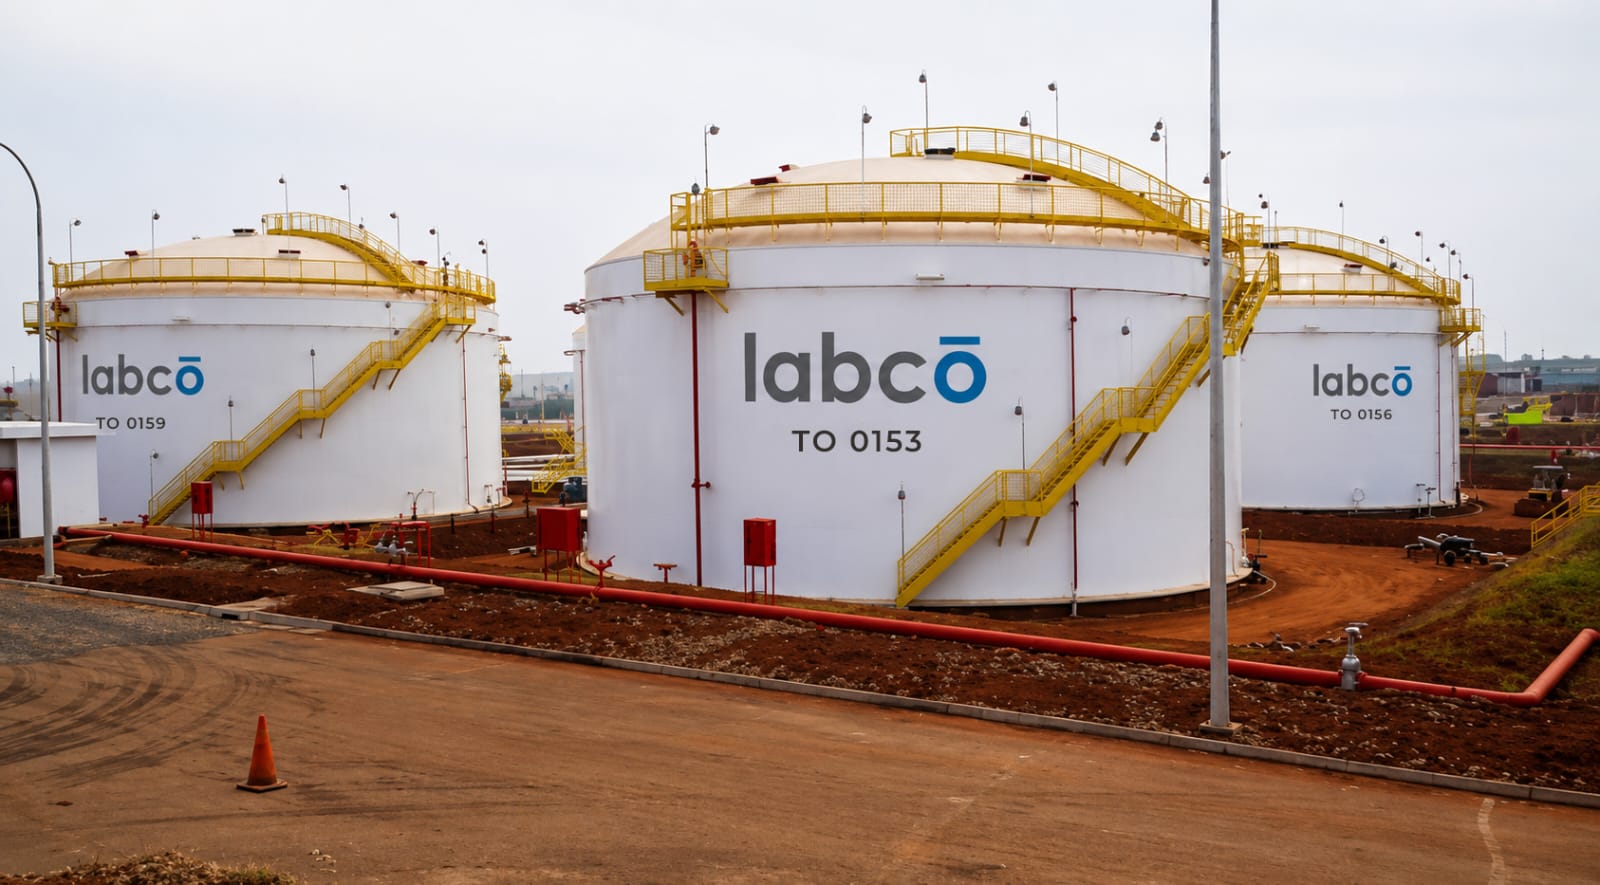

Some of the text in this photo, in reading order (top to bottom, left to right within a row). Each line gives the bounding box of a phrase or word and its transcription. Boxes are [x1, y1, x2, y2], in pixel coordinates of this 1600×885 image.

[1330, 409, 1393, 420] TO 0156
[96, 417, 166, 430] TO 0159
[792, 430, 922, 453] TO 0153
